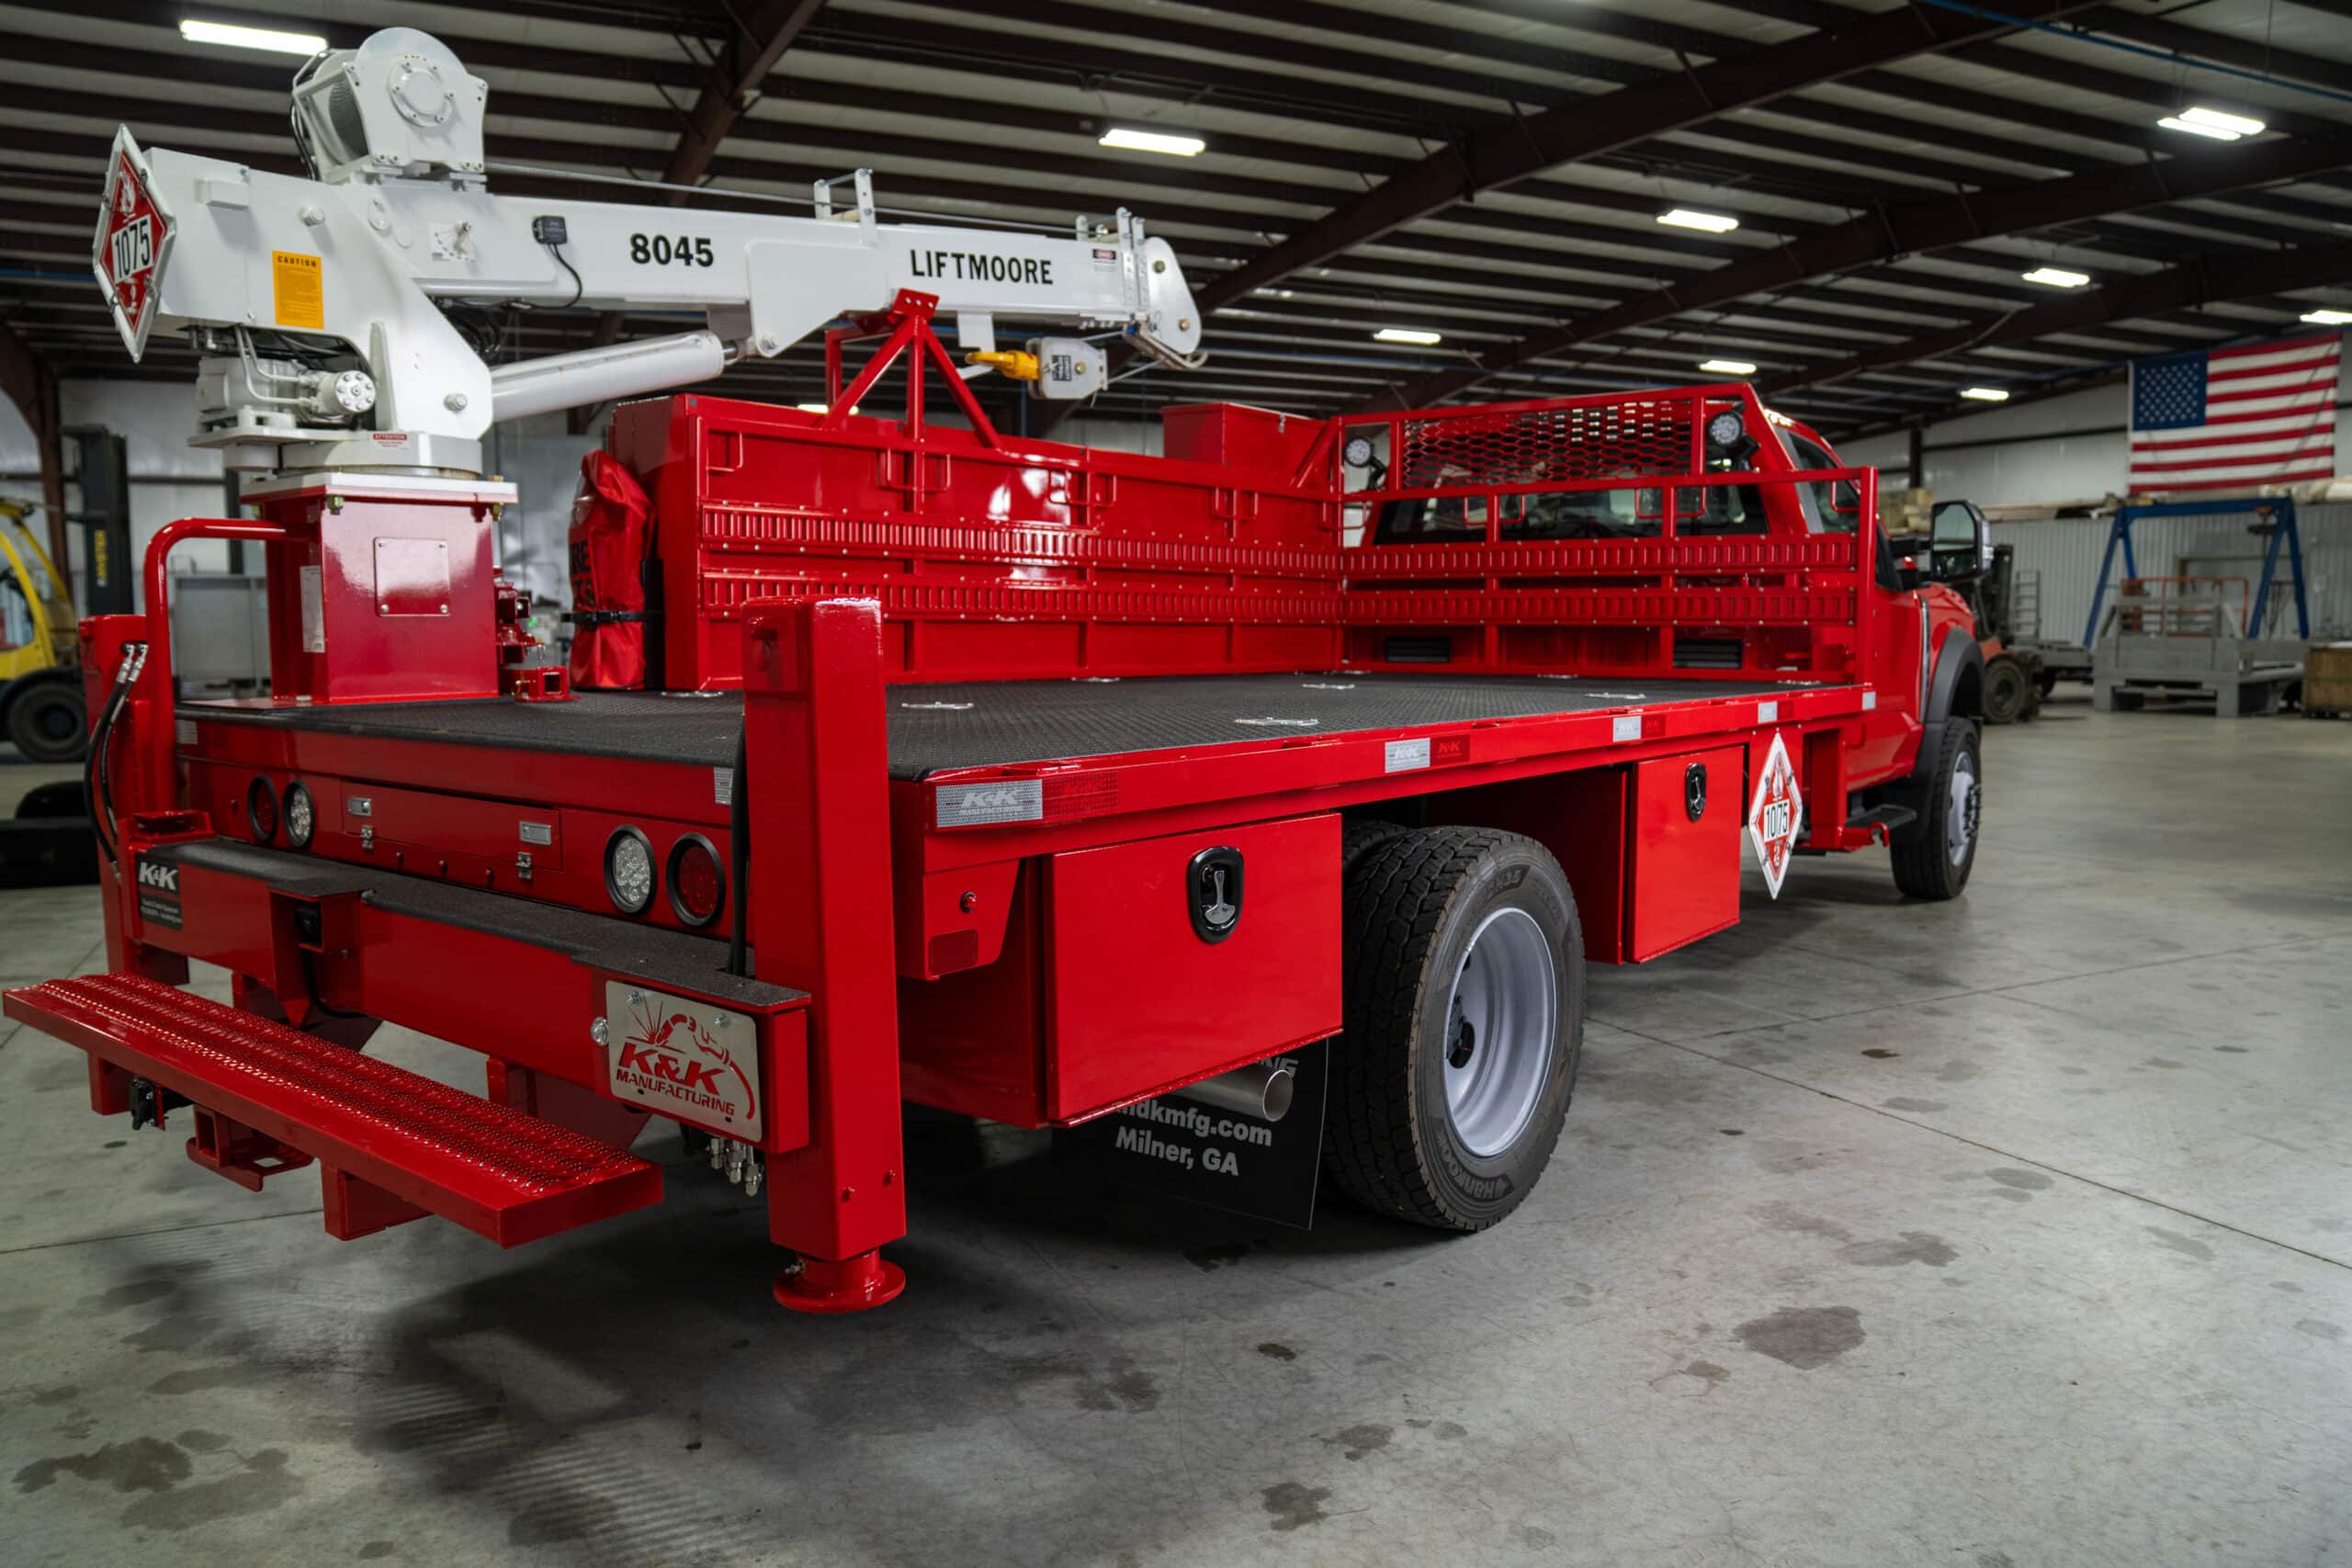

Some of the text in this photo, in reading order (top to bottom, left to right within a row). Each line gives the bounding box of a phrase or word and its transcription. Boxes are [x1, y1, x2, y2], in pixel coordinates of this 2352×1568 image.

[115, 220, 150, 279] 1075
[277, 255, 317, 267] CAUTION
[630, 232, 714, 267] 8045
[910, 249, 1054, 286] LIFTMOORE
[1766, 802, 1789, 840] 1075
[139, 862, 179, 891] K&K
[618, 1042, 726, 1096] K&K
[616, 1069, 735, 1115] MANUFACTURING
[1117, 1099, 1272, 1147] ndkmfg.com
[1115, 1126, 1239, 1177] Milner, GA
